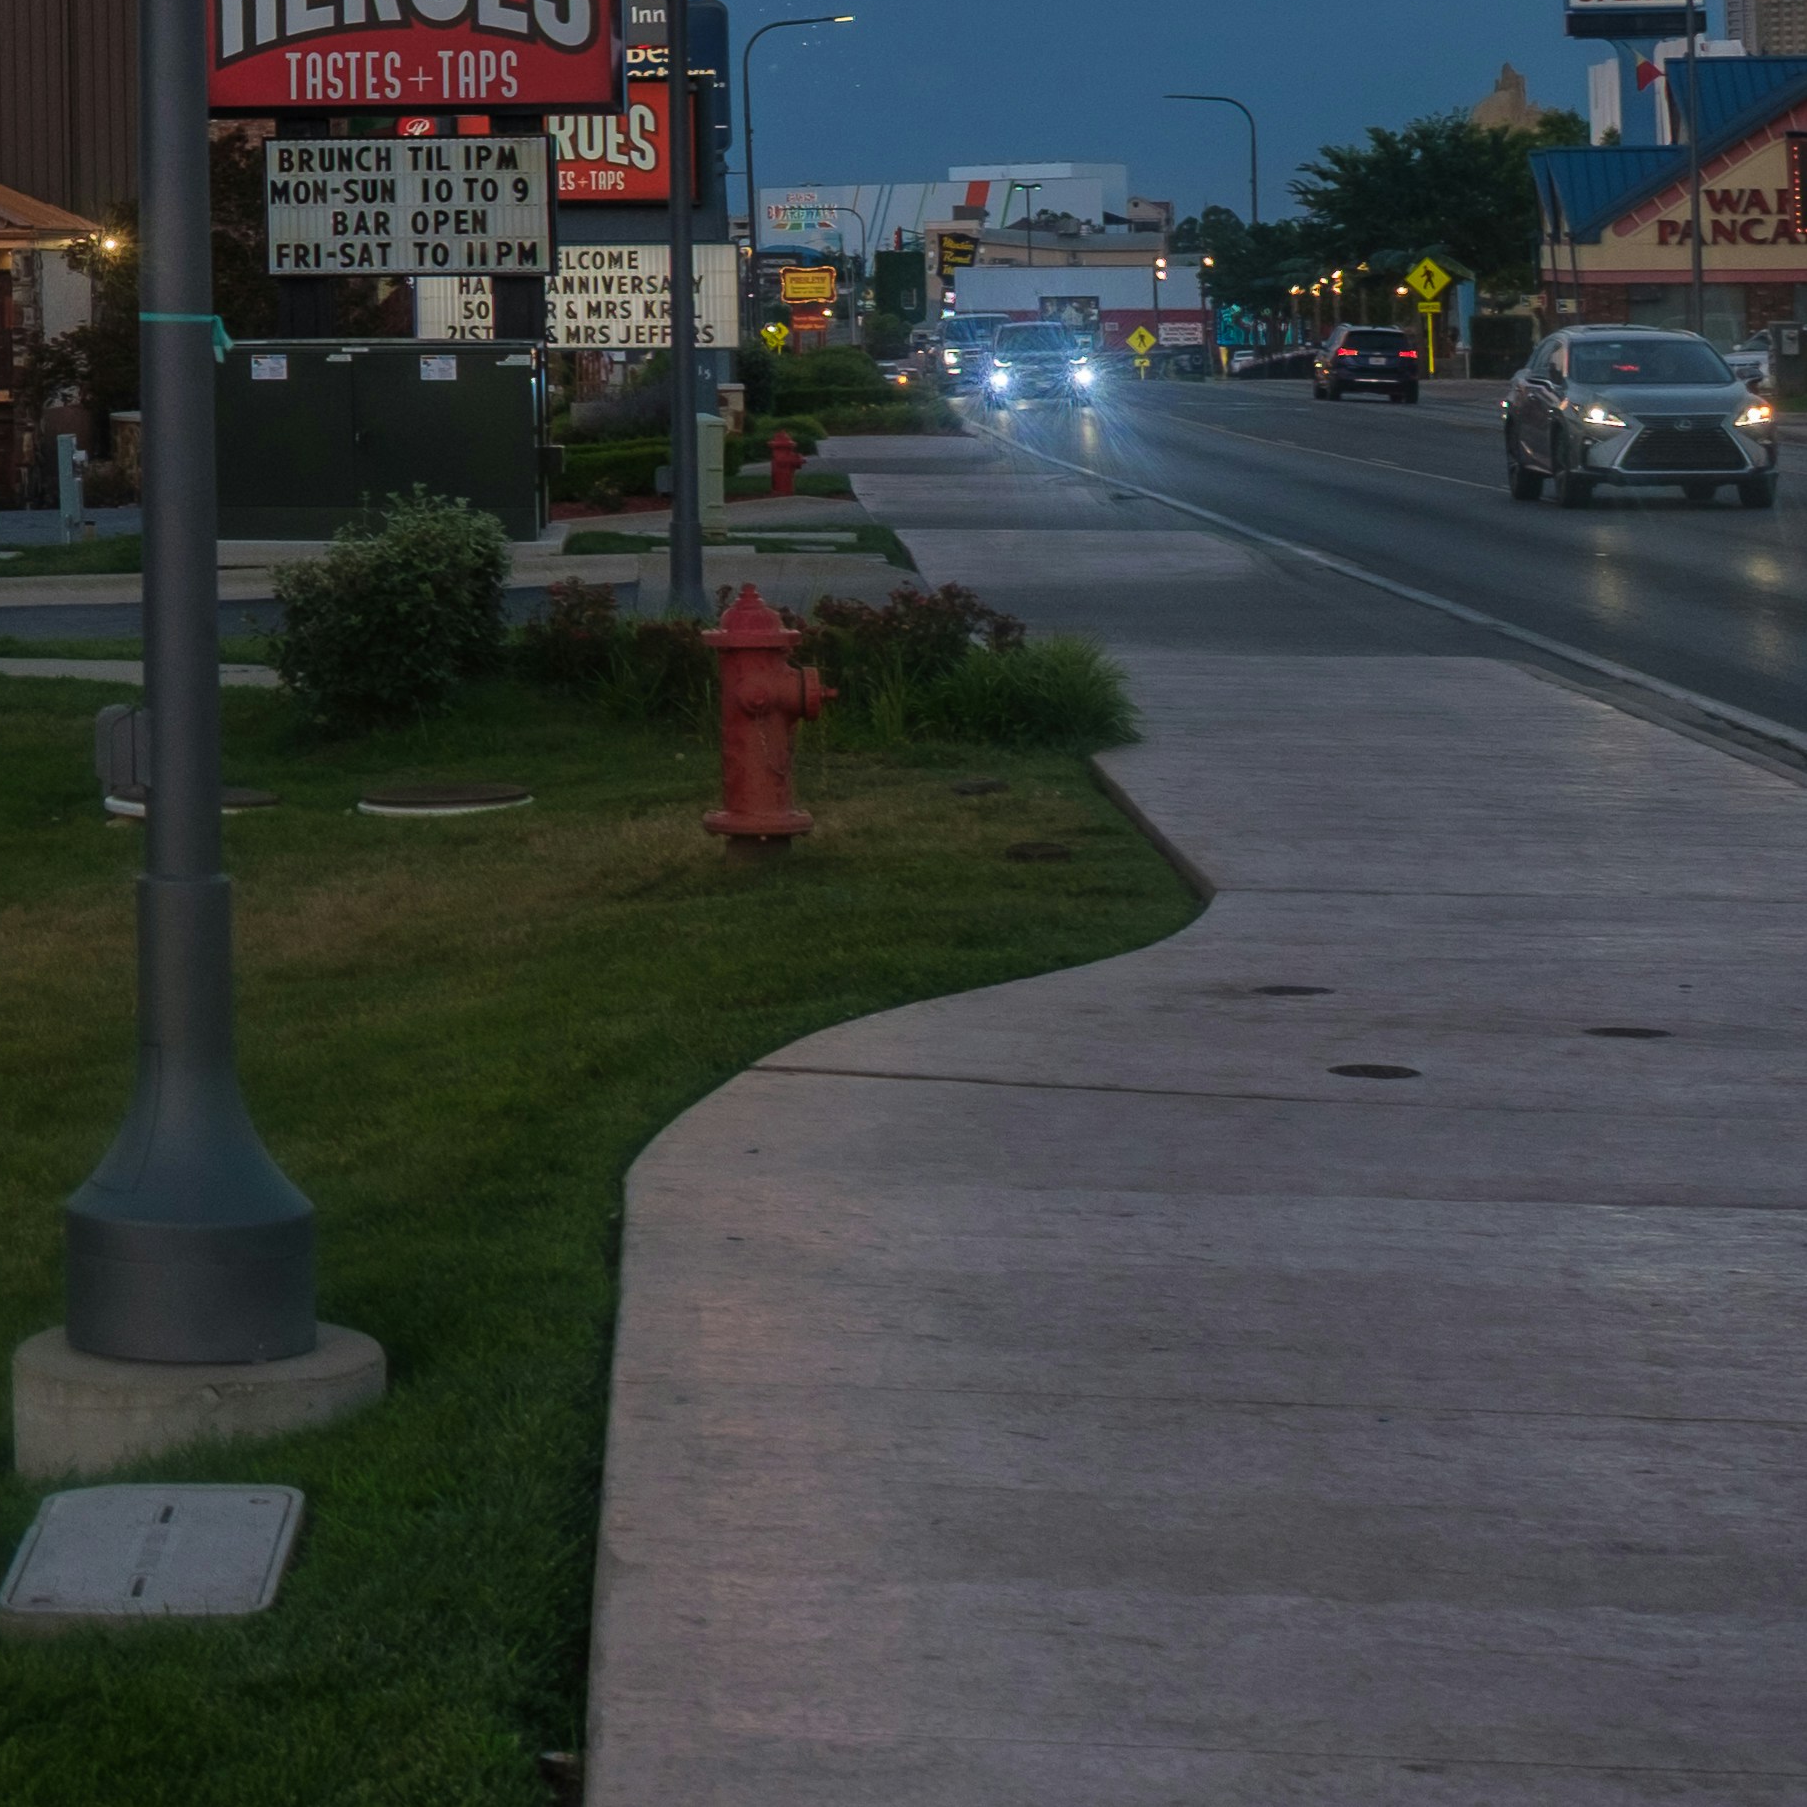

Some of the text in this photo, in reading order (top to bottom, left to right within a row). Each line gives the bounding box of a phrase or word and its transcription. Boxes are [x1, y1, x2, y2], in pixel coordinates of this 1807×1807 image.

[631, 6, 667, 24] Inn
[286, 51, 402, 100] TASTES
[438, 50, 519, 99] TAPS
[278, 147, 392, 173] BRUNCH
[407, 145, 451, 172] TIL
[270, 178, 396, 205] MON-SUN
[463, 177, 498, 203] TO
[512, 177, 529, 203] 9
[590, 171, 625, 191] TAPS
[332, 210, 488, 236] BAR OPEN
[275, 243, 392, 268] FRI-SAT
[413, 243, 449, 267] TO
[558, 251, 639, 270] ELCOME
[547, 275, 704, 294] ANNIVERSAY
[565, 301, 578, 319] &
[587, 301, 632, 319] MRS
[566, 325, 611, 344] MRS
